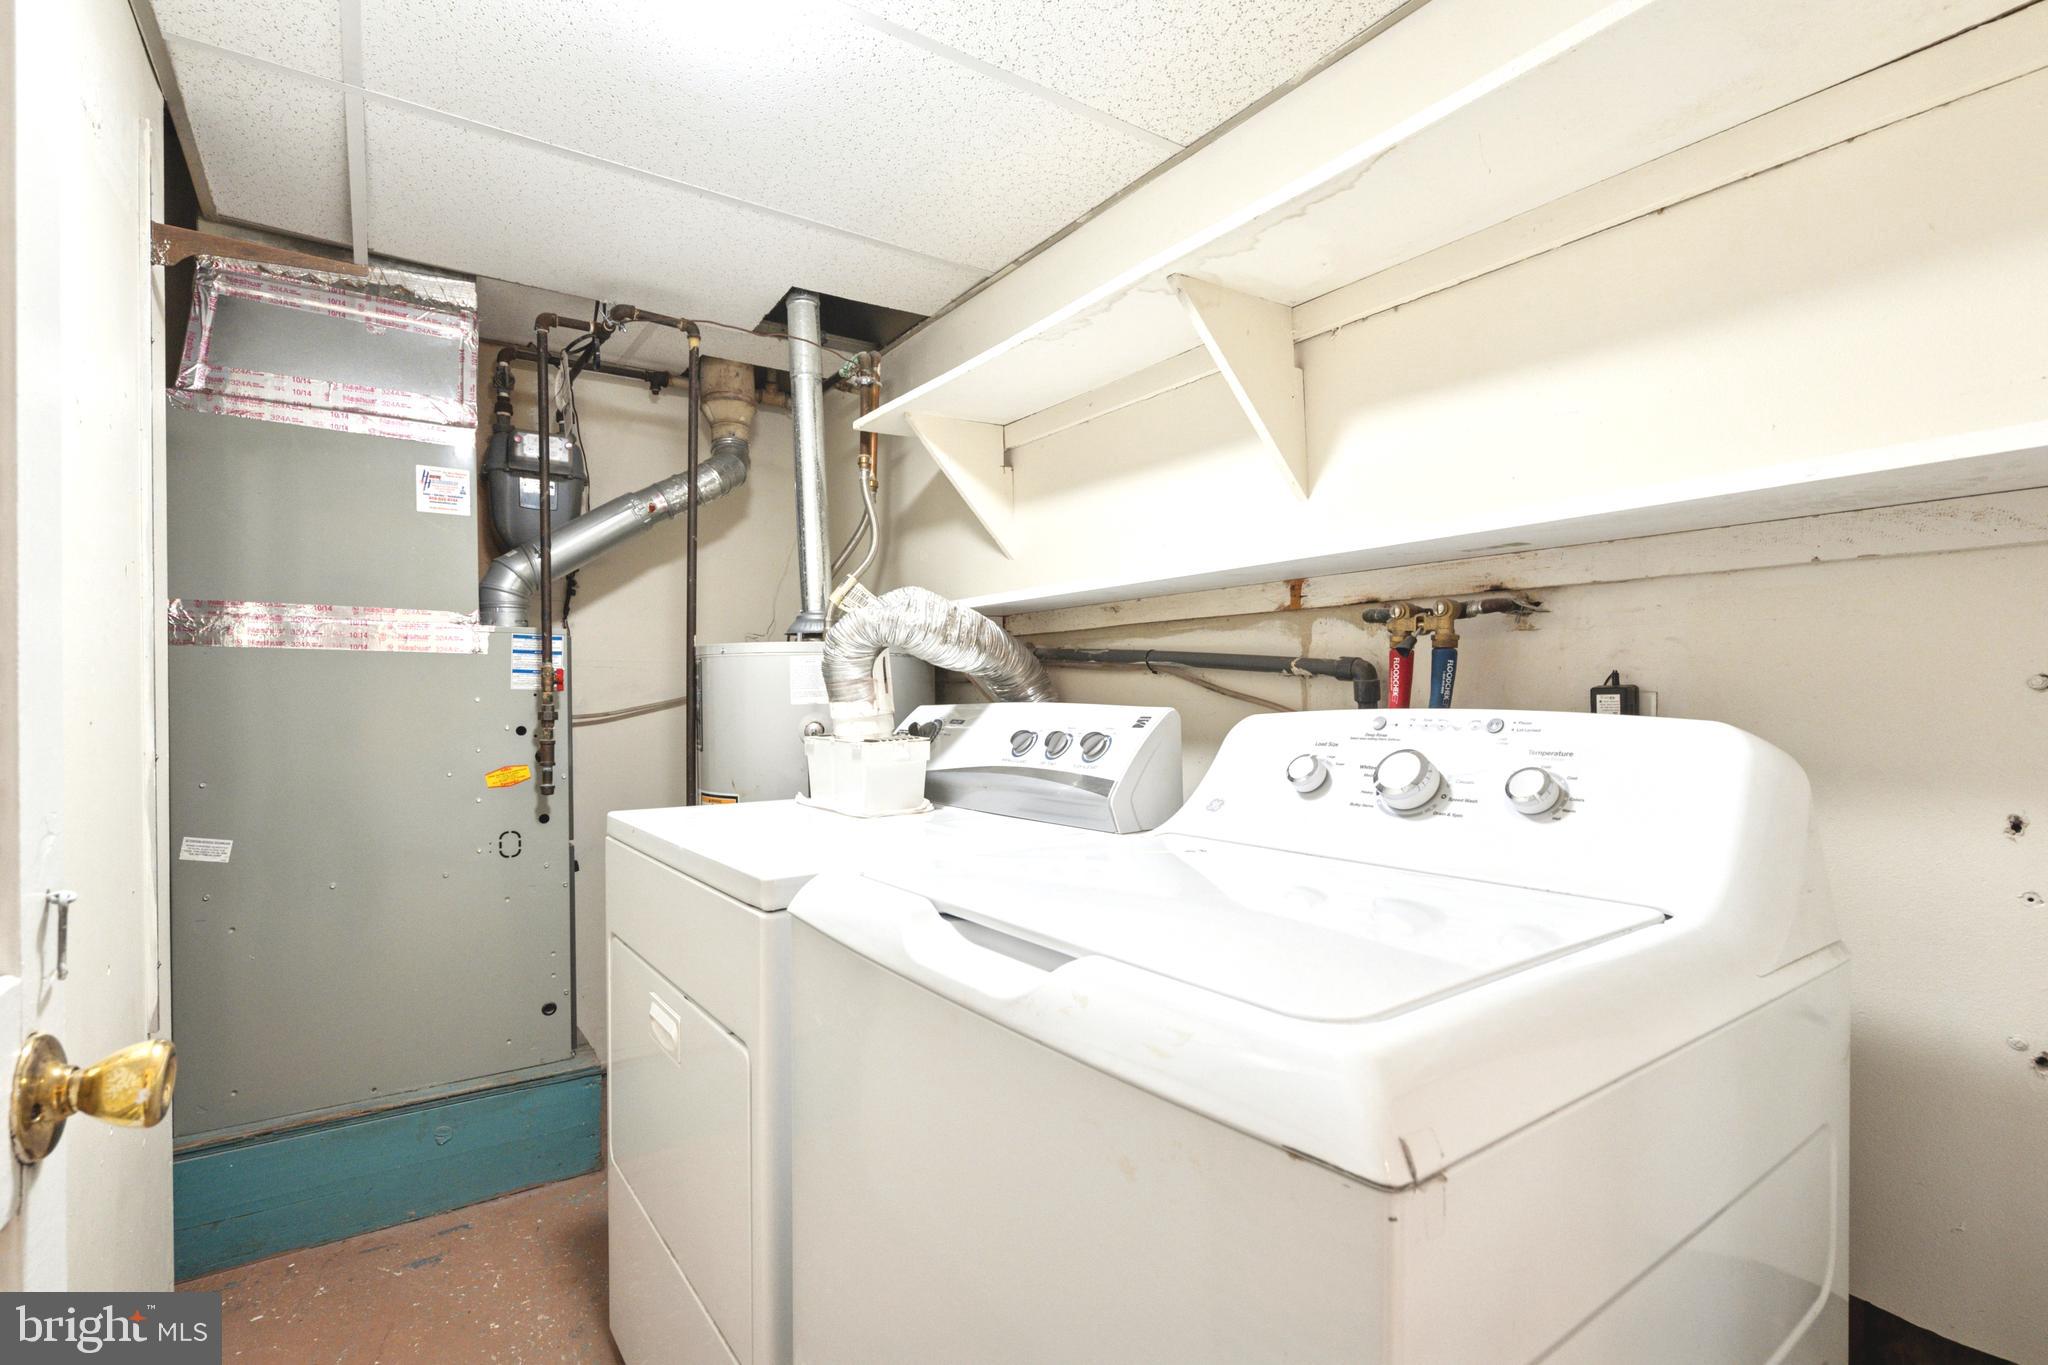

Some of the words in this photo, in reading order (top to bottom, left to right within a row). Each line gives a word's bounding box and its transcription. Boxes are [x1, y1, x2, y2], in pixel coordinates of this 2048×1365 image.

[328, 298, 346, 307] 10/14
[328, 310, 346, 319] 10/14
[292, 376, 312, 385] 10/14
[292, 388, 312, 397] 10/14
[1528, 749, 1575, 758] Temperature
